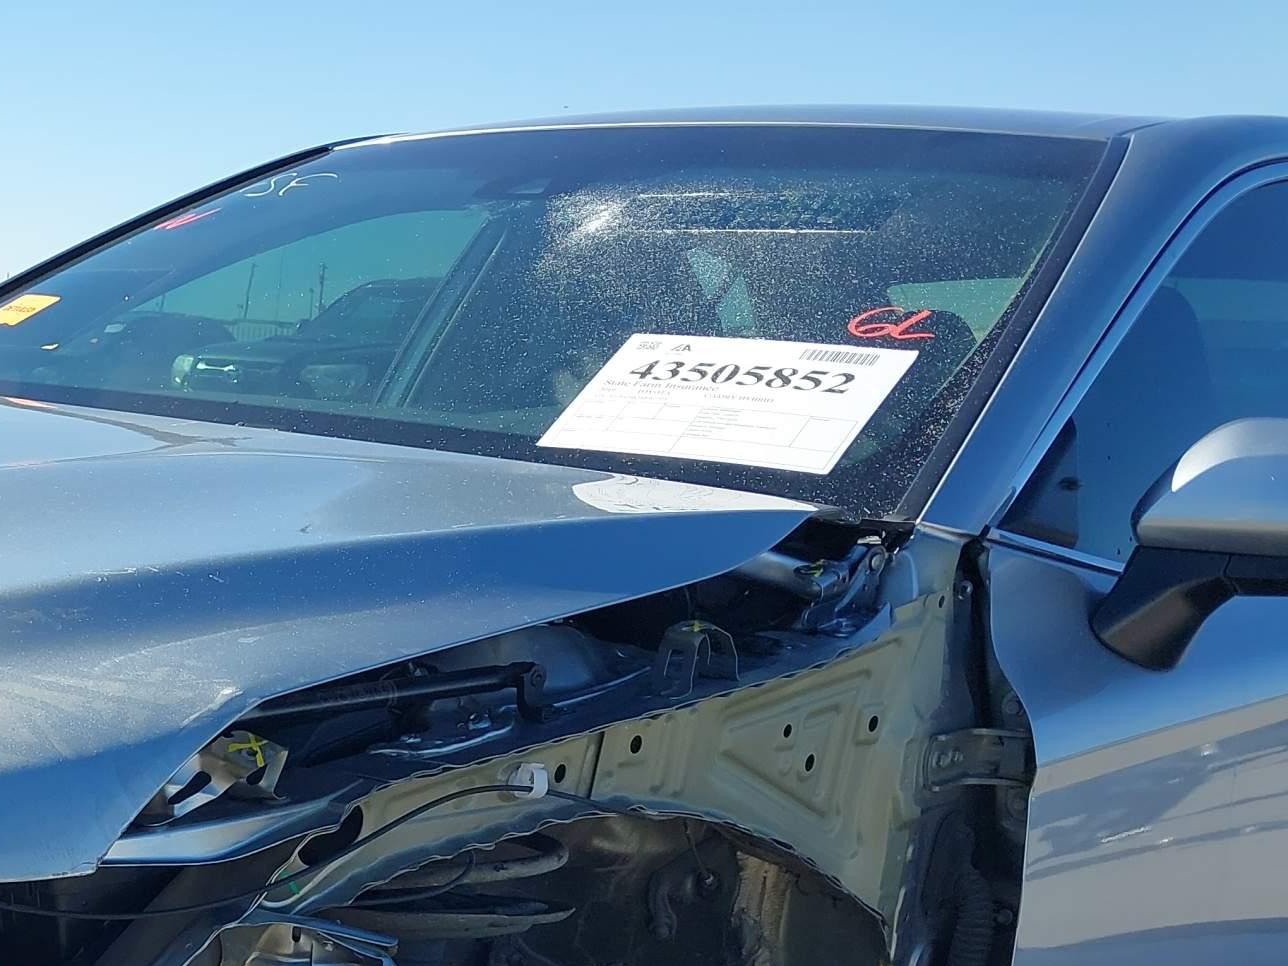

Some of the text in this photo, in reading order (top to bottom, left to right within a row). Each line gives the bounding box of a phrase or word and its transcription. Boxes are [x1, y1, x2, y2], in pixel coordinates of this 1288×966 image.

[604, 379, 720, 392] State Farm Insurance
[629, 359, 857, 395] 43505852
